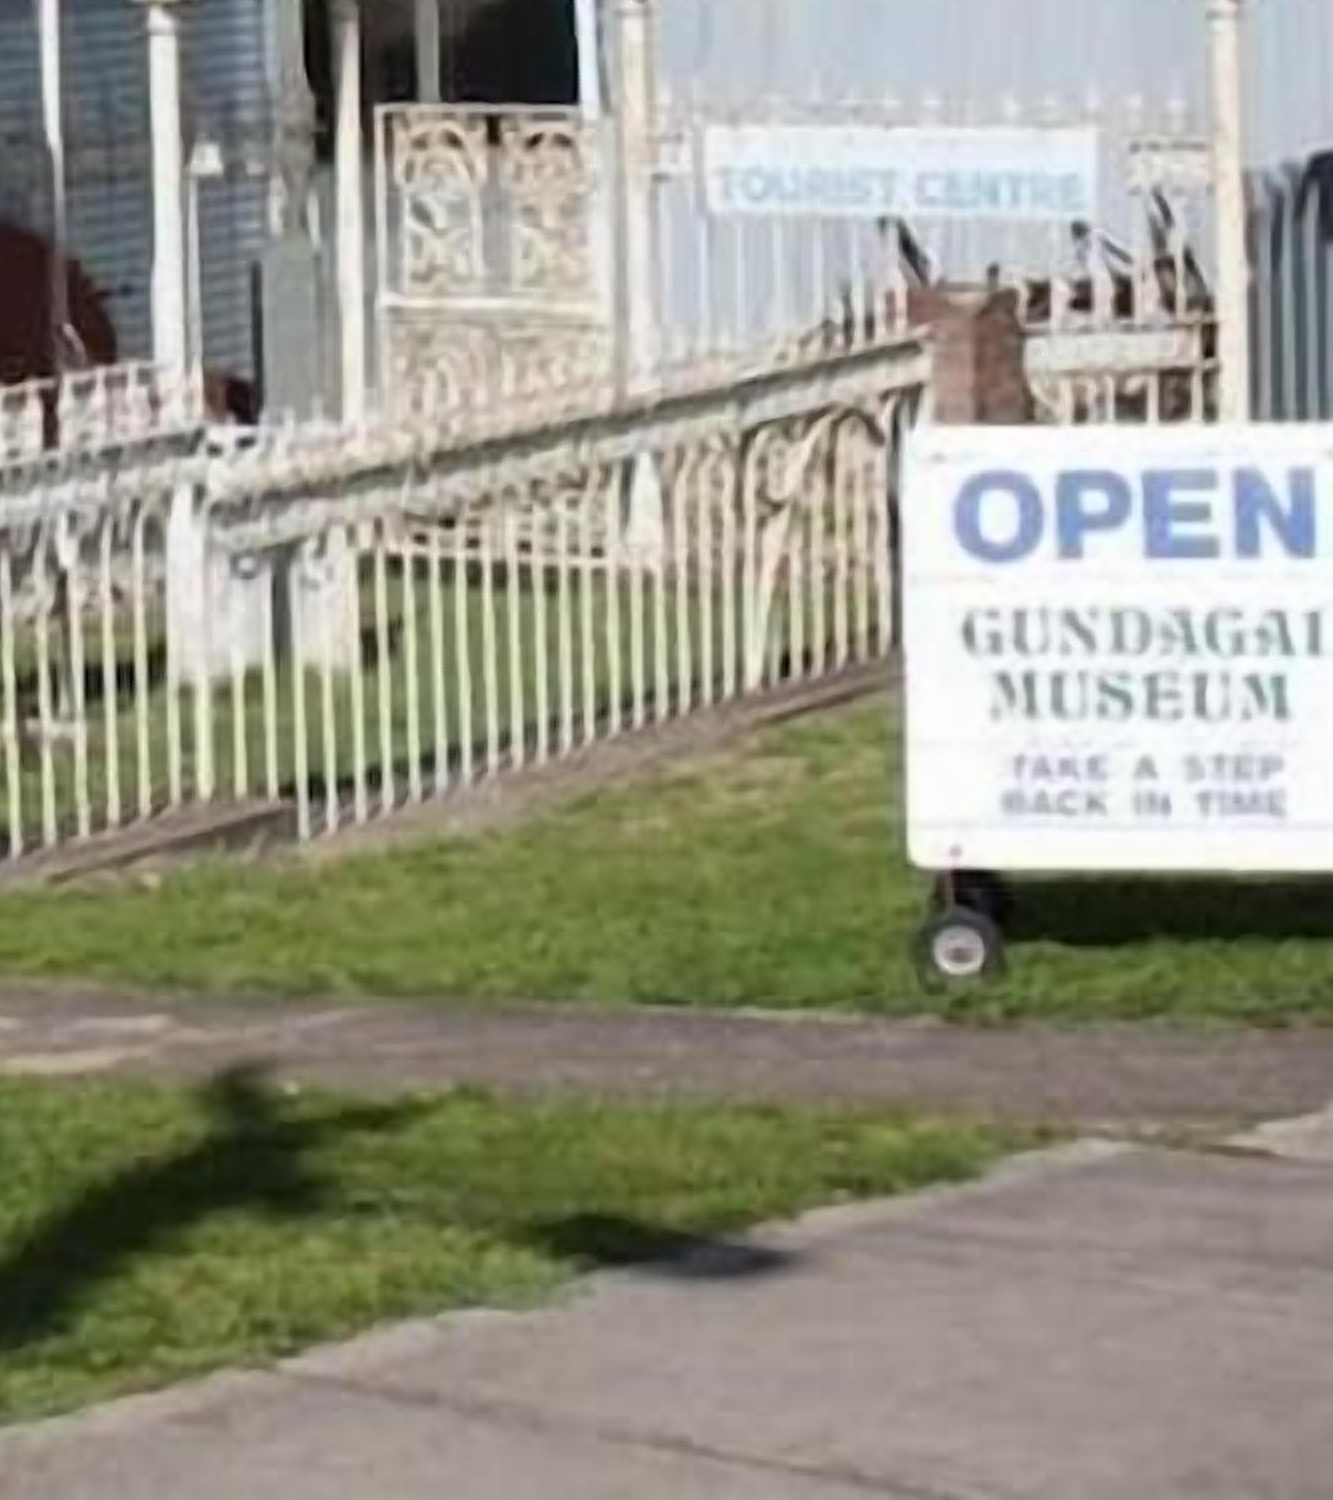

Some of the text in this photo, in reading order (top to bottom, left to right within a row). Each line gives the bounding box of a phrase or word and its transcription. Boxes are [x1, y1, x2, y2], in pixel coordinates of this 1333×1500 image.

[715, 166, 1085, 209] TOURIST CENTRE
[953, 467, 1317, 563] OPEN
[960, 607, 1325, 658] GUNDAGAI
[989, 670, 1292, 722] MUSEUM
[1013, 753, 1286, 781] TAKE A STEP
[1001, 789, 1287, 817] BACK IN TIME
